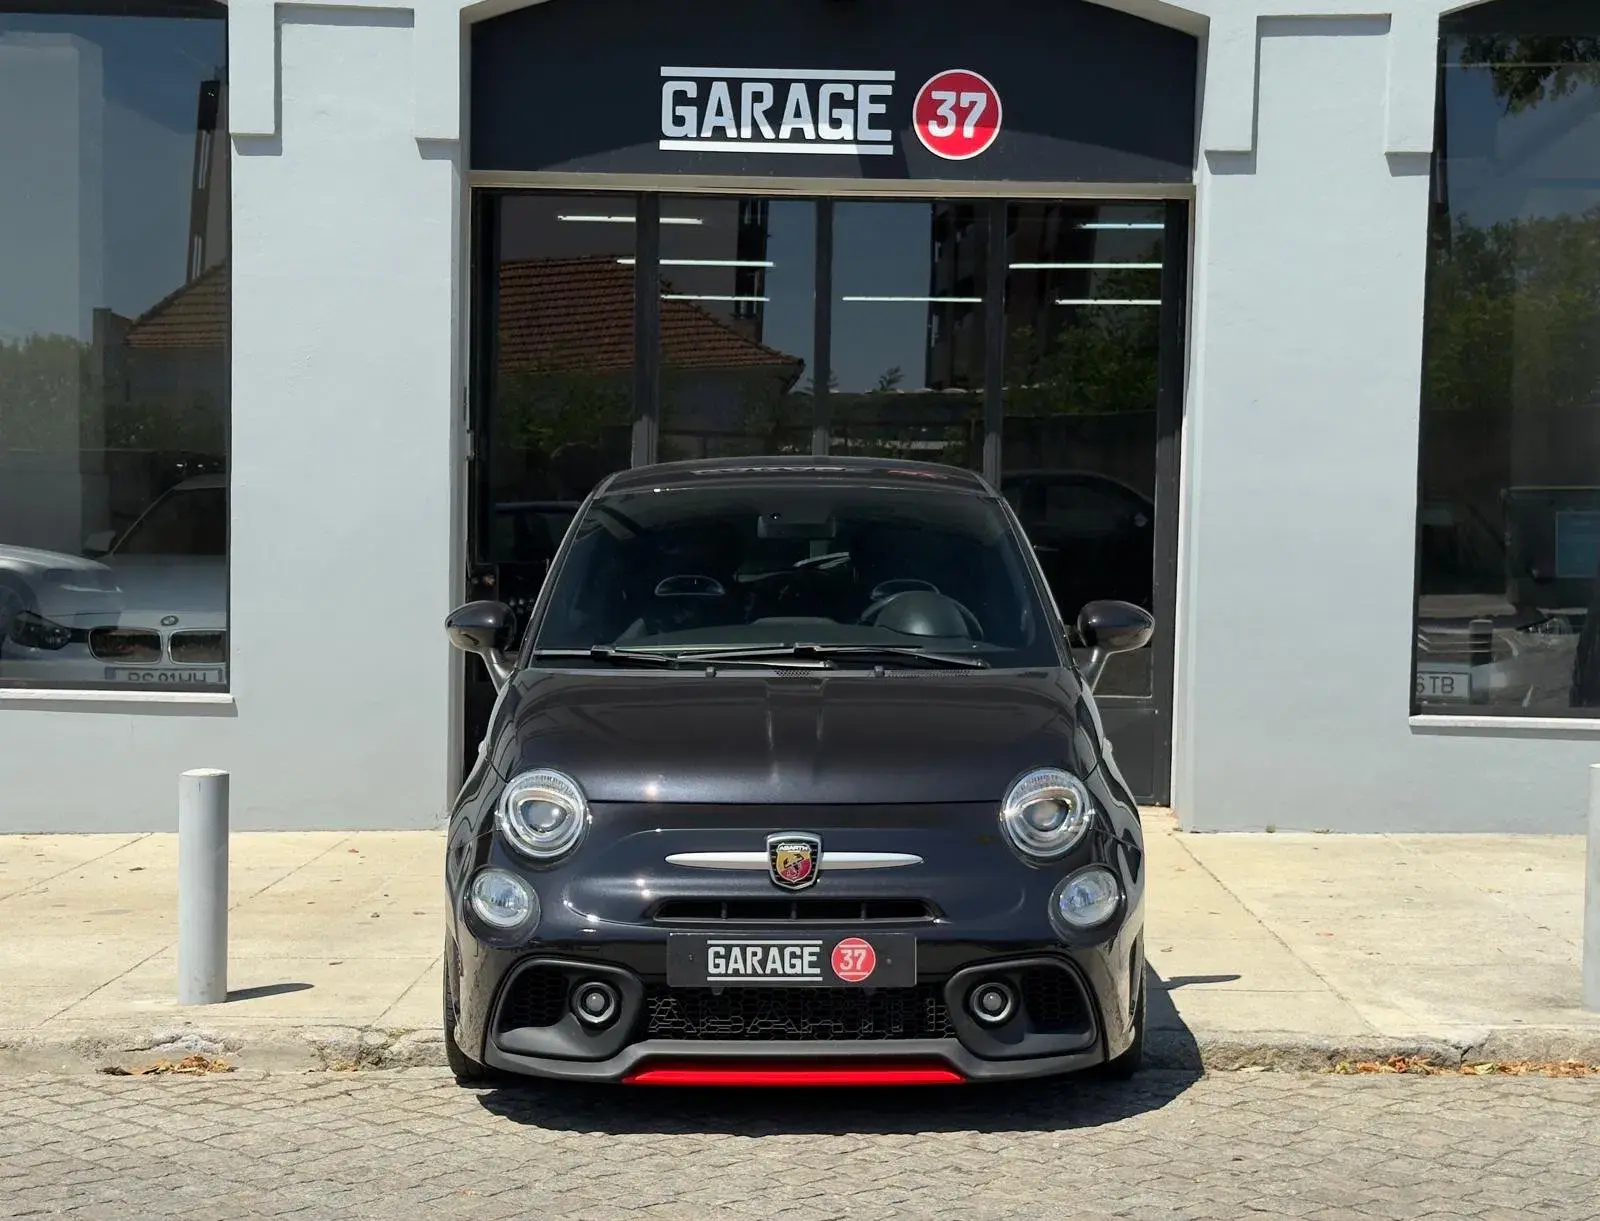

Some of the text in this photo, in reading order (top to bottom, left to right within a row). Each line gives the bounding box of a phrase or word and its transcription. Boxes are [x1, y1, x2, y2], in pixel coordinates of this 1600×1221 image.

[661, 80, 987, 141] GARAGE 37
[708, 946, 867, 974] GARAGE 37
